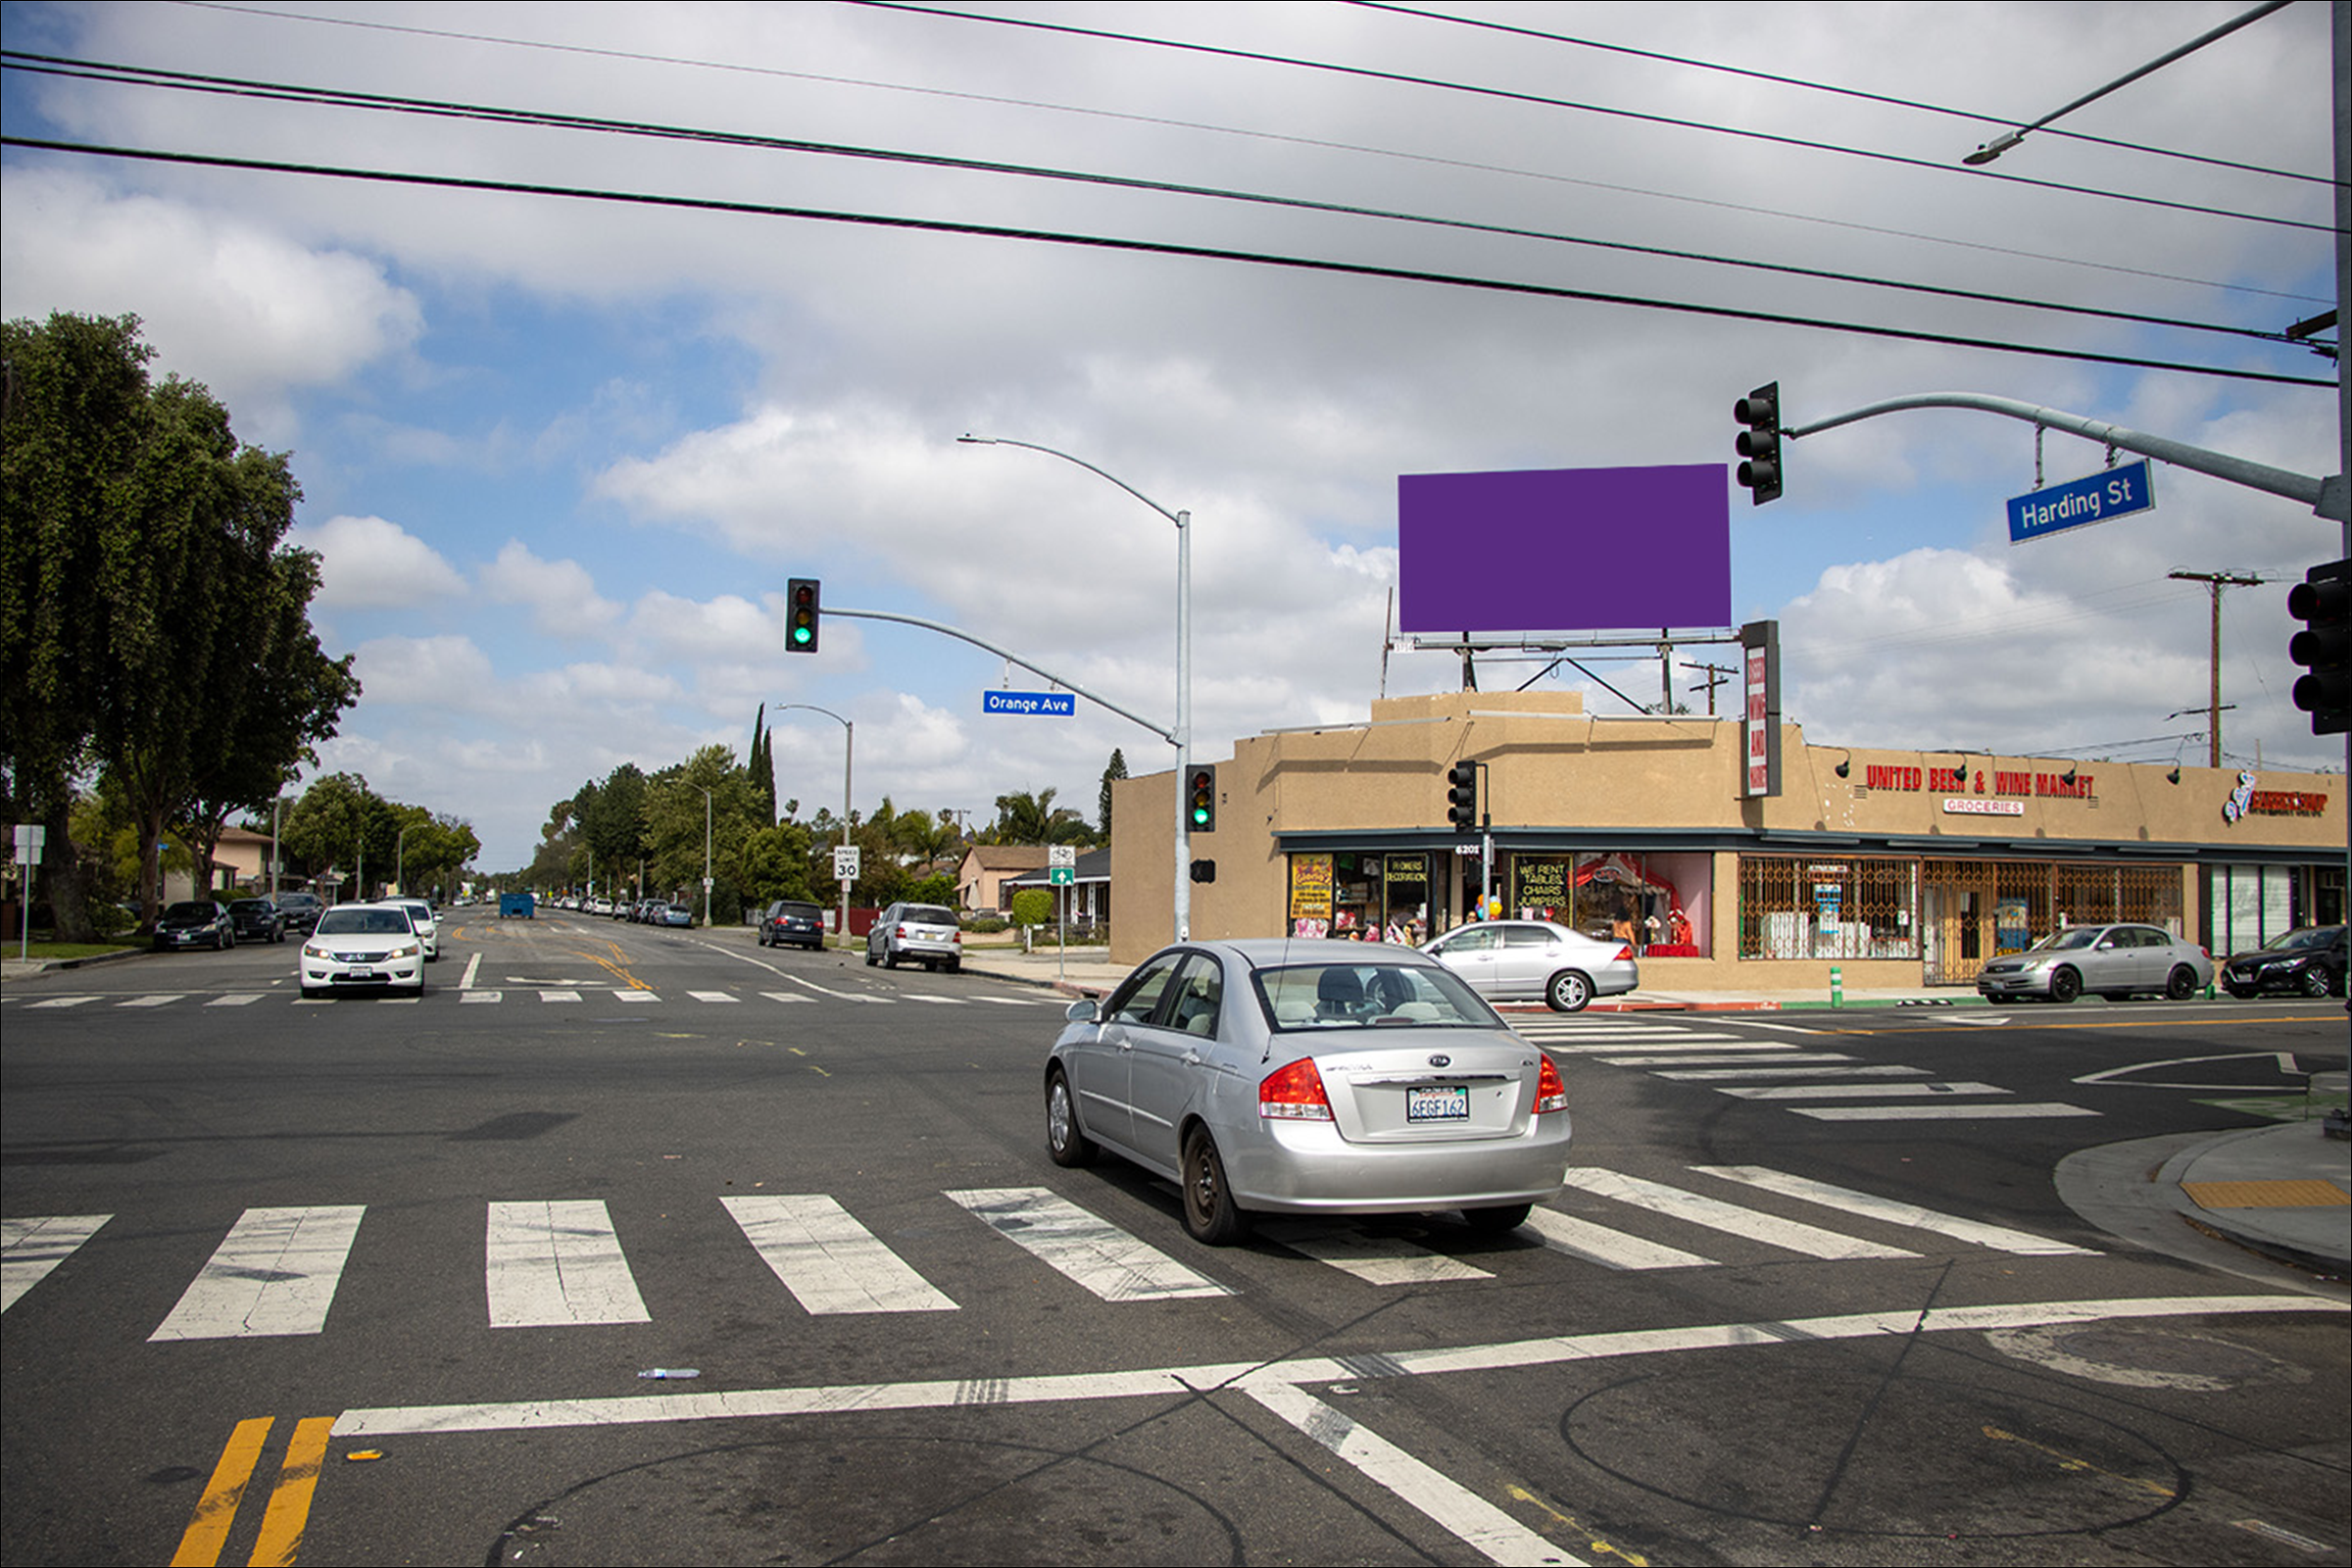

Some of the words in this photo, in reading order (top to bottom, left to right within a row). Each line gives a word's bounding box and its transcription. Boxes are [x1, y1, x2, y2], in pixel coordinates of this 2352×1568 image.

[2022, 491, 2101, 528] Harding
[2108, 477, 2132, 505] St
[989, 695, 1038, 713] Orange
[1042, 698, 1068, 711] Ave
[1866, 764, 1923, 790] UNITED
[1974, 769, 1986, 792] &
[1994, 771, 2032, 796] WINE
[1947, 799, 2021, 814] GROCERIES
[1455, 845, 1480, 855] 6201
[838, 864, 857, 876] 30
[1519, 864, 1536, 875] WE
[1538, 864, 1565, 875] RENT
[1523, 886, 1562, 896] CHAIRS
[1518, 897, 1566, 906] JUMPERS
